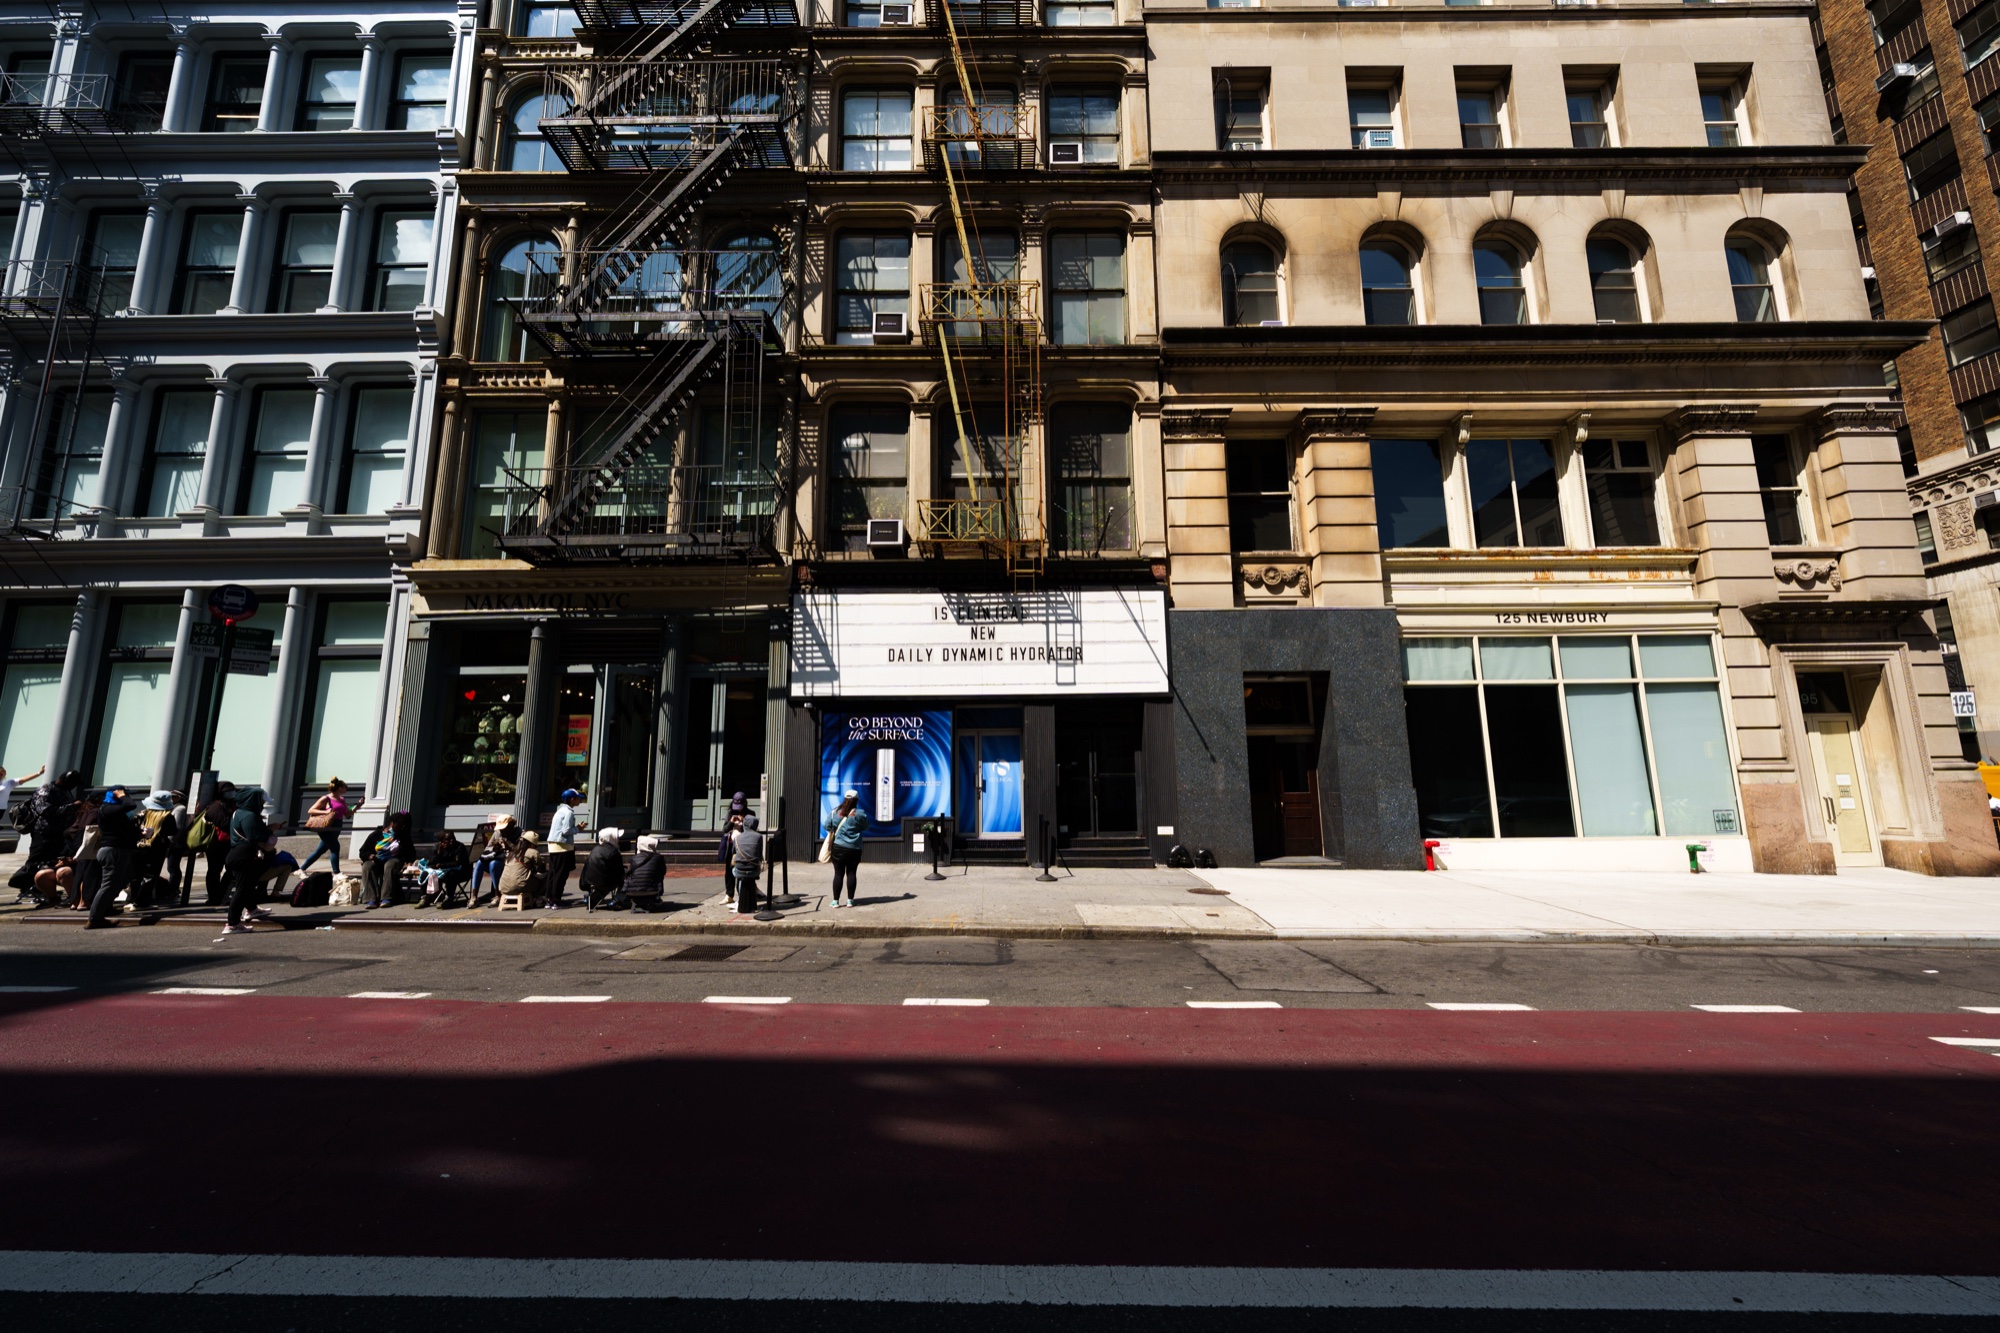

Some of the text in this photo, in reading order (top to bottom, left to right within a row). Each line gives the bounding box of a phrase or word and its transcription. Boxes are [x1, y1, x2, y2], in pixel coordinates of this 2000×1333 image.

[465, 593, 630, 609] NAKAMOL NYC
[934, 606, 1027, 620] IS CLINICAL
[1495, 612, 1609, 624] 125 NEWBURY
[970, 626, 996, 640] NEW
[888, 647, 1083, 662] DAILY DYNAMIC HYDRATOR
[1953, 694, 1974, 714] 125
[848, 716, 923, 729] GO BEYOND
[848, 728, 924, 741] the SURFACE
